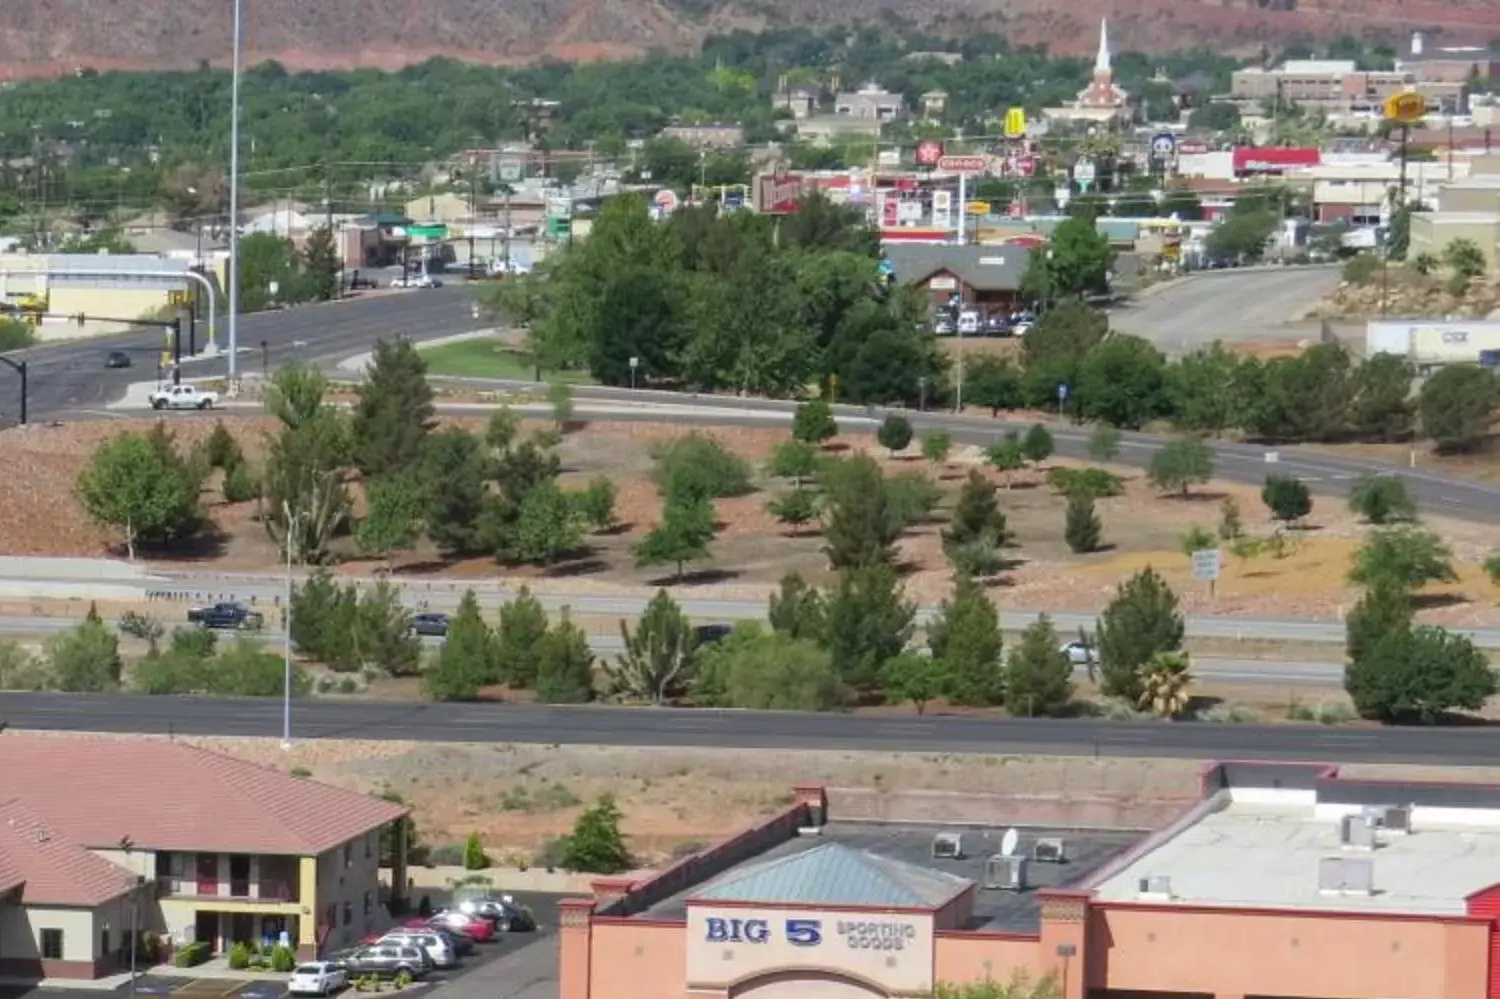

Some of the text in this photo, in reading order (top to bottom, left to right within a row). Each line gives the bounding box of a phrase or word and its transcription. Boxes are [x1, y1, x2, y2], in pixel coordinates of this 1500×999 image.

[706, 917, 916, 946] BIG 5 SPORTING
[847, 936, 904, 950] GOODS
